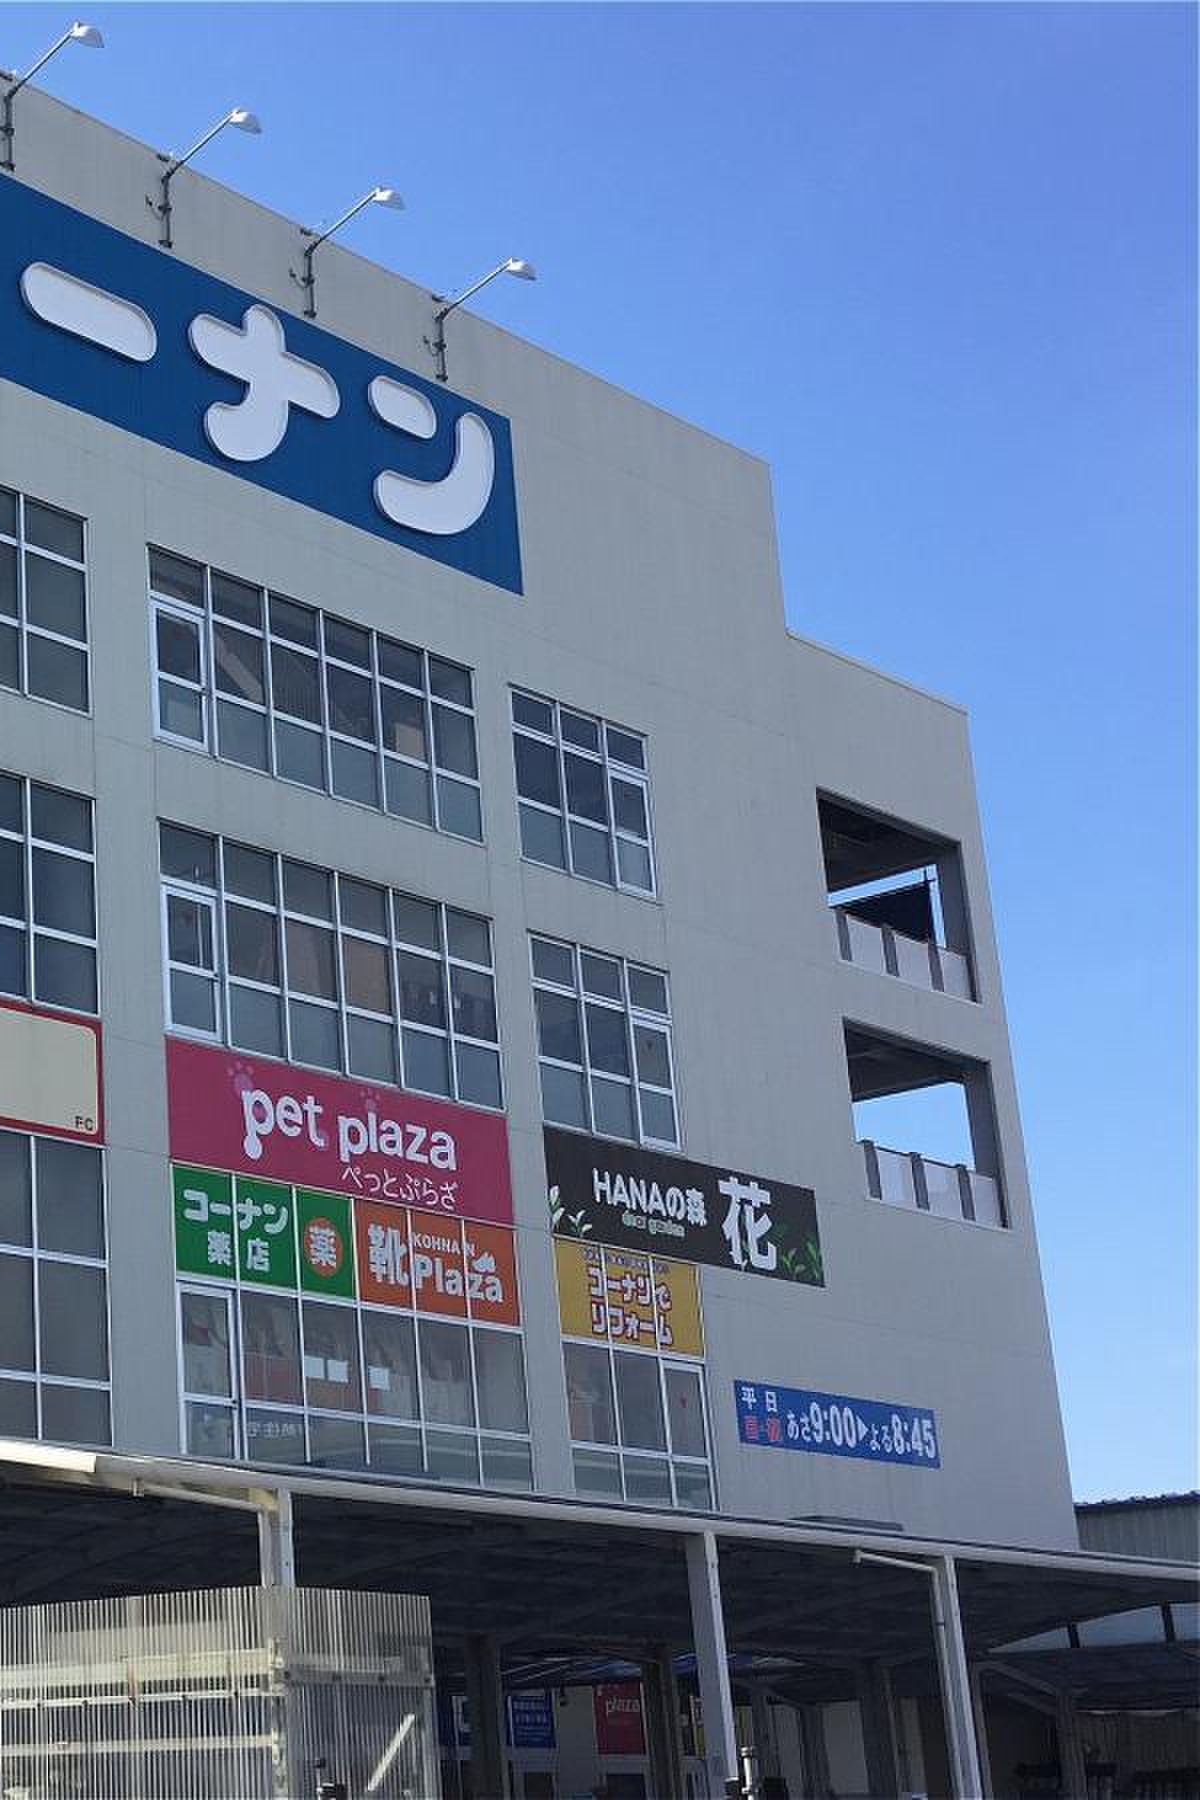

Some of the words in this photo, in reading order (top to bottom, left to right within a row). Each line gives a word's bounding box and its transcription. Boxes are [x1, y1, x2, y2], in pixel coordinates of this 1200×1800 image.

[75, 1116, 93, 1131] FC
[241, 1088, 326, 1160] pet
[337, 1113, 457, 1171] plaza
[183, 1189, 289, 1234] コーナン
[718, 1176, 778, 1271] 花
[413, 1232, 476, 1257] KOHNAN
[415, 1253, 504, 1303] Plaza
